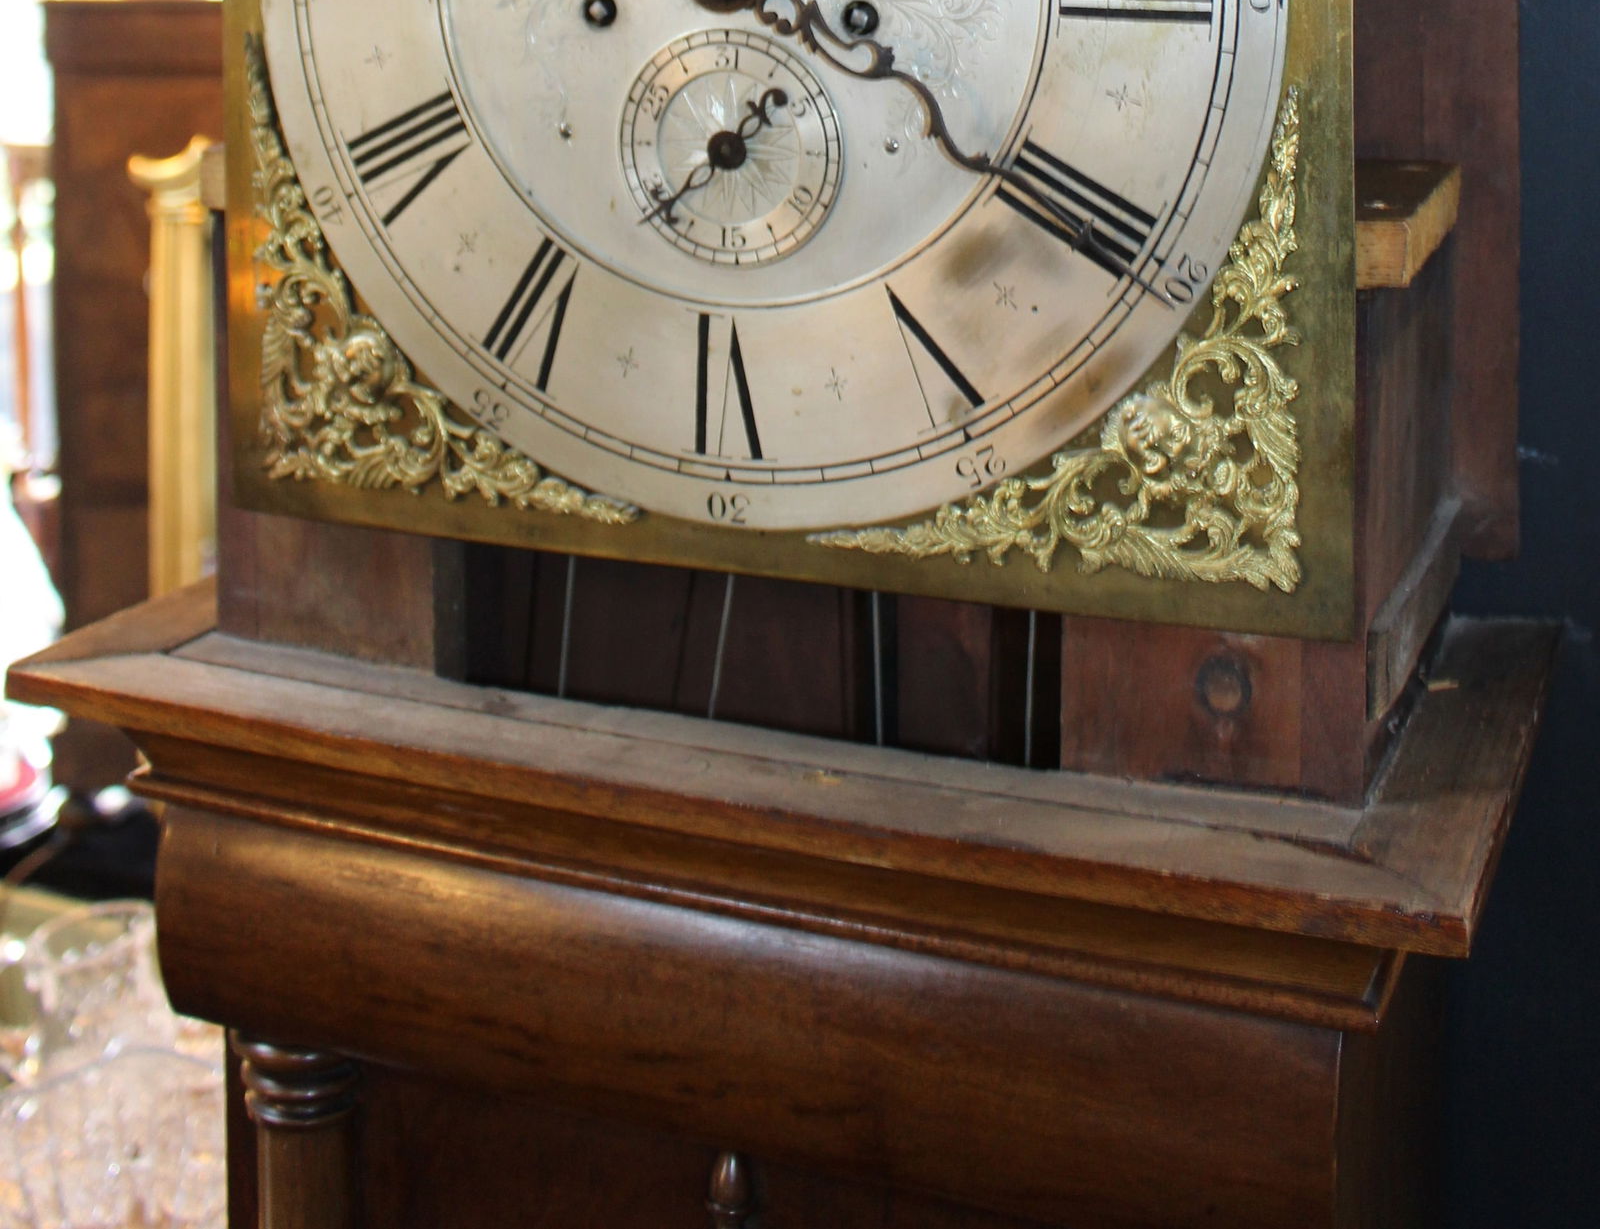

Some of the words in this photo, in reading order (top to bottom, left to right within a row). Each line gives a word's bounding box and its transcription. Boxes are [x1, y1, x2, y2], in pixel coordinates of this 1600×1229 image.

[715, 45, 740, 71] 31
[640, 84, 670, 122] 25
[790, 96, 815, 118] 5
[340, 77, 474, 238] VIII
[311, 185, 344, 227] 40
[786, 185, 814, 216] 10
[719, 226, 747, 249] 15
[1164, 253, 1208, 305] 20
[468, 224, 582, 400] VII
[882, 282, 996, 434] V
[690, 313, 776, 462] VI
[470, 388, 510, 432] 35
[955, 444, 1007, 487] 25
[706, 491, 751, 524] 30
